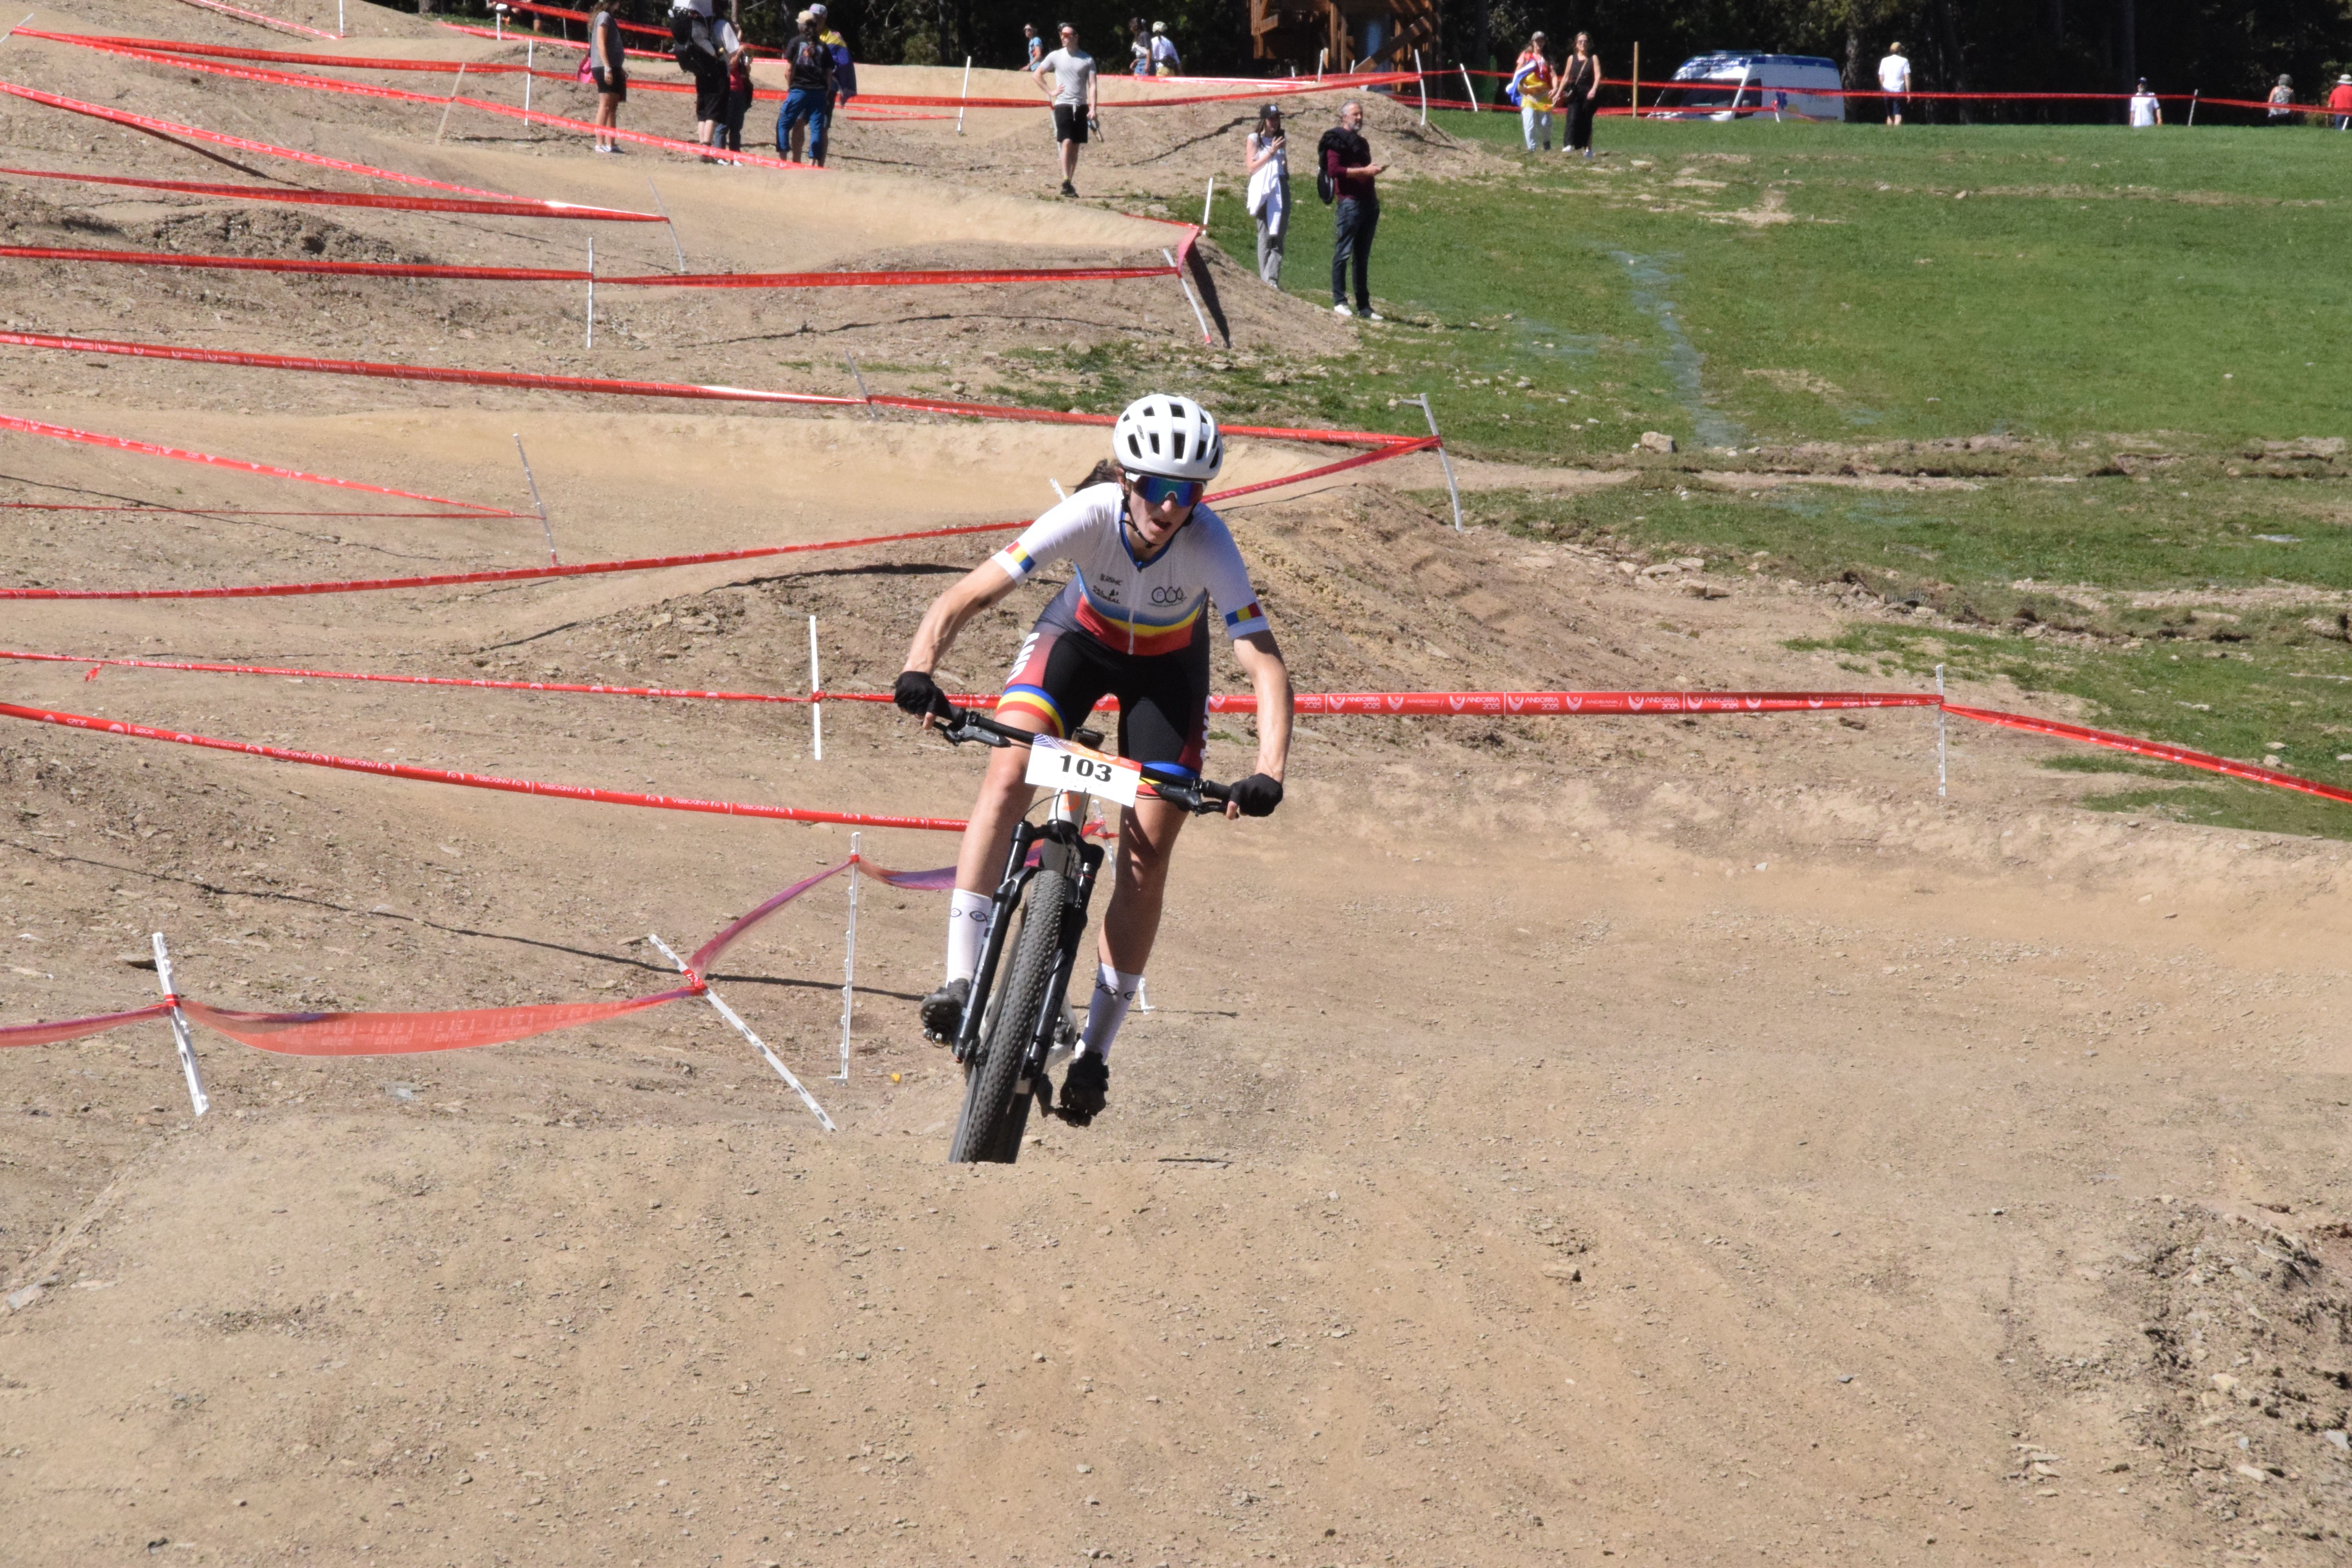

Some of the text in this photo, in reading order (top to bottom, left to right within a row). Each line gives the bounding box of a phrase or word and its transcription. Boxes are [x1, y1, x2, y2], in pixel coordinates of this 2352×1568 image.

[338, 757, 376, 767] ANDORRA
[1060, 755, 1112, 782] 103
[473, 774, 511, 784] ANDORRA
[538, 782, 576, 792] ANDORRA
[672, 797, 709, 806] ANDORRA
